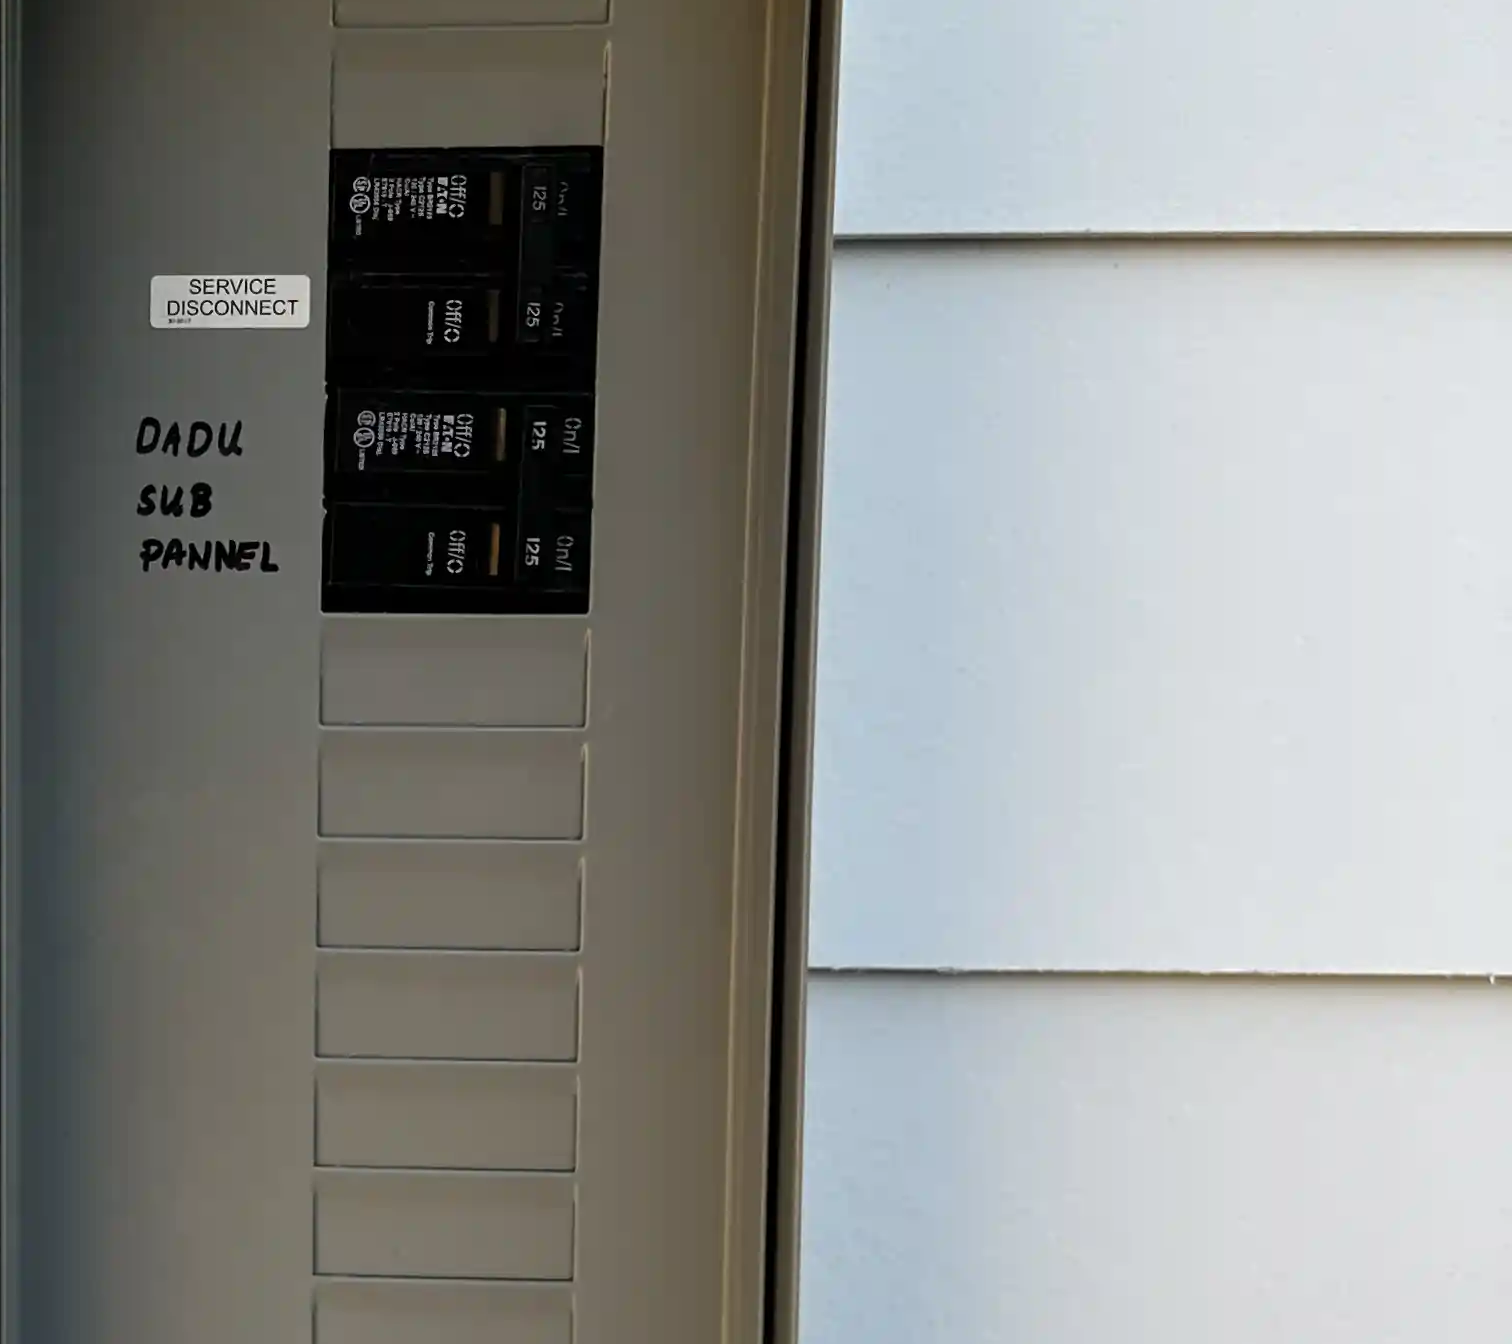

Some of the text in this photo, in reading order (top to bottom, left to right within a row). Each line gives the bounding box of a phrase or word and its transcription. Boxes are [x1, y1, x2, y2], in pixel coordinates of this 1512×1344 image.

[532, 185, 547, 211] 125
[189, 278, 277, 295] SERVICE
[167, 299, 298, 316] DISCONNECT
[526, 302, 541, 328] 125
[136, 416, 243, 457] DADU
[532, 421, 547, 450] 125
[137, 482, 213, 518] SUB
[139, 538, 280, 573] PANNEL
[524, 537, 540, 566] 125
